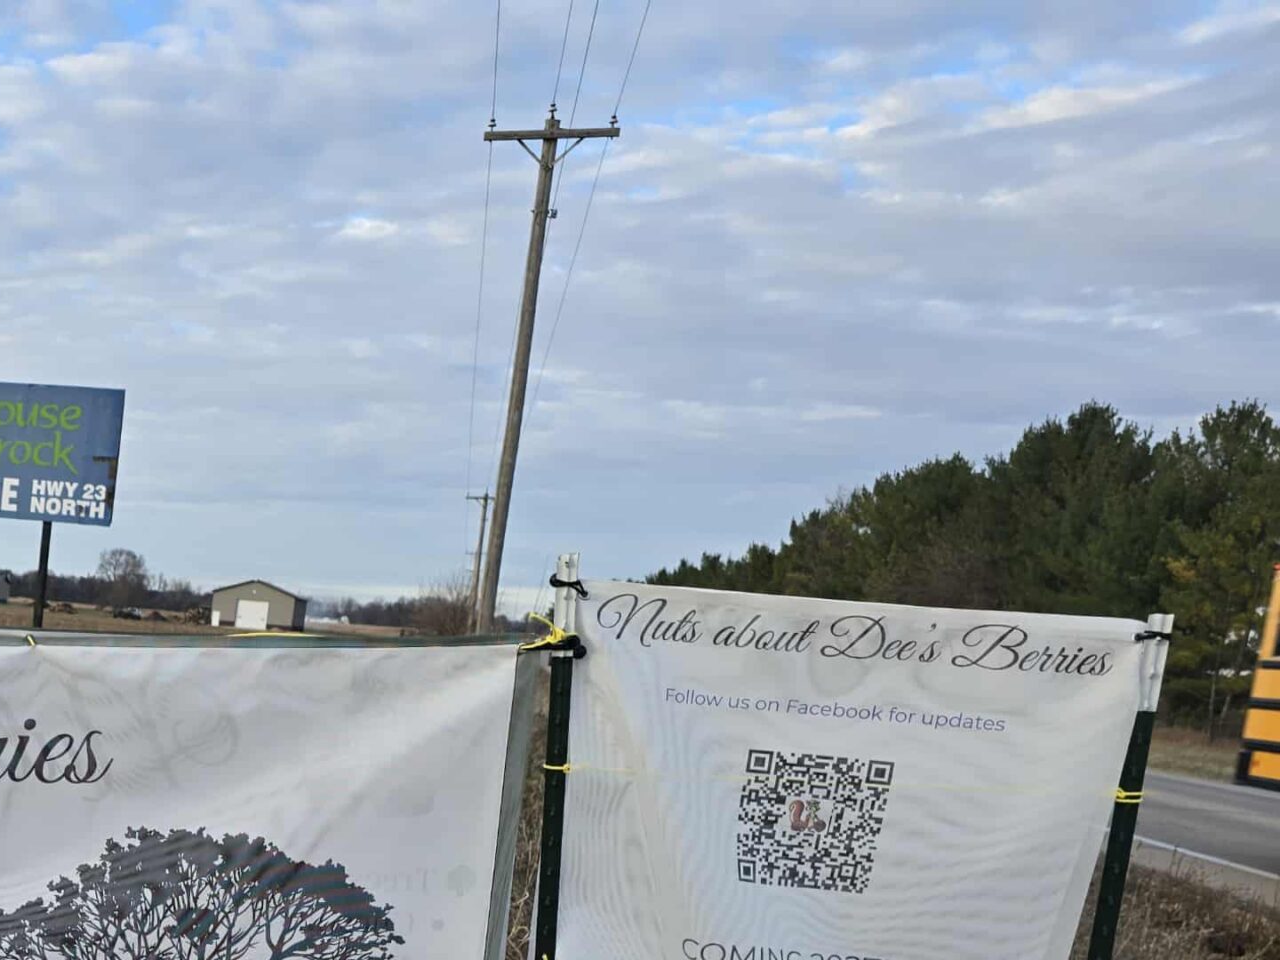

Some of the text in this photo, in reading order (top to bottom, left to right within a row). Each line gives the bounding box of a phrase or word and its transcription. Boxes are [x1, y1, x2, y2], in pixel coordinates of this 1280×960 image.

[31, 479, 107, 500] HWY 23
[30, 496, 105, 519] NORTH
[596, 593, 1114, 678] Nuts about Dee's Berries
[665, 687, 1006, 734] Follow us on Facebook for updates
